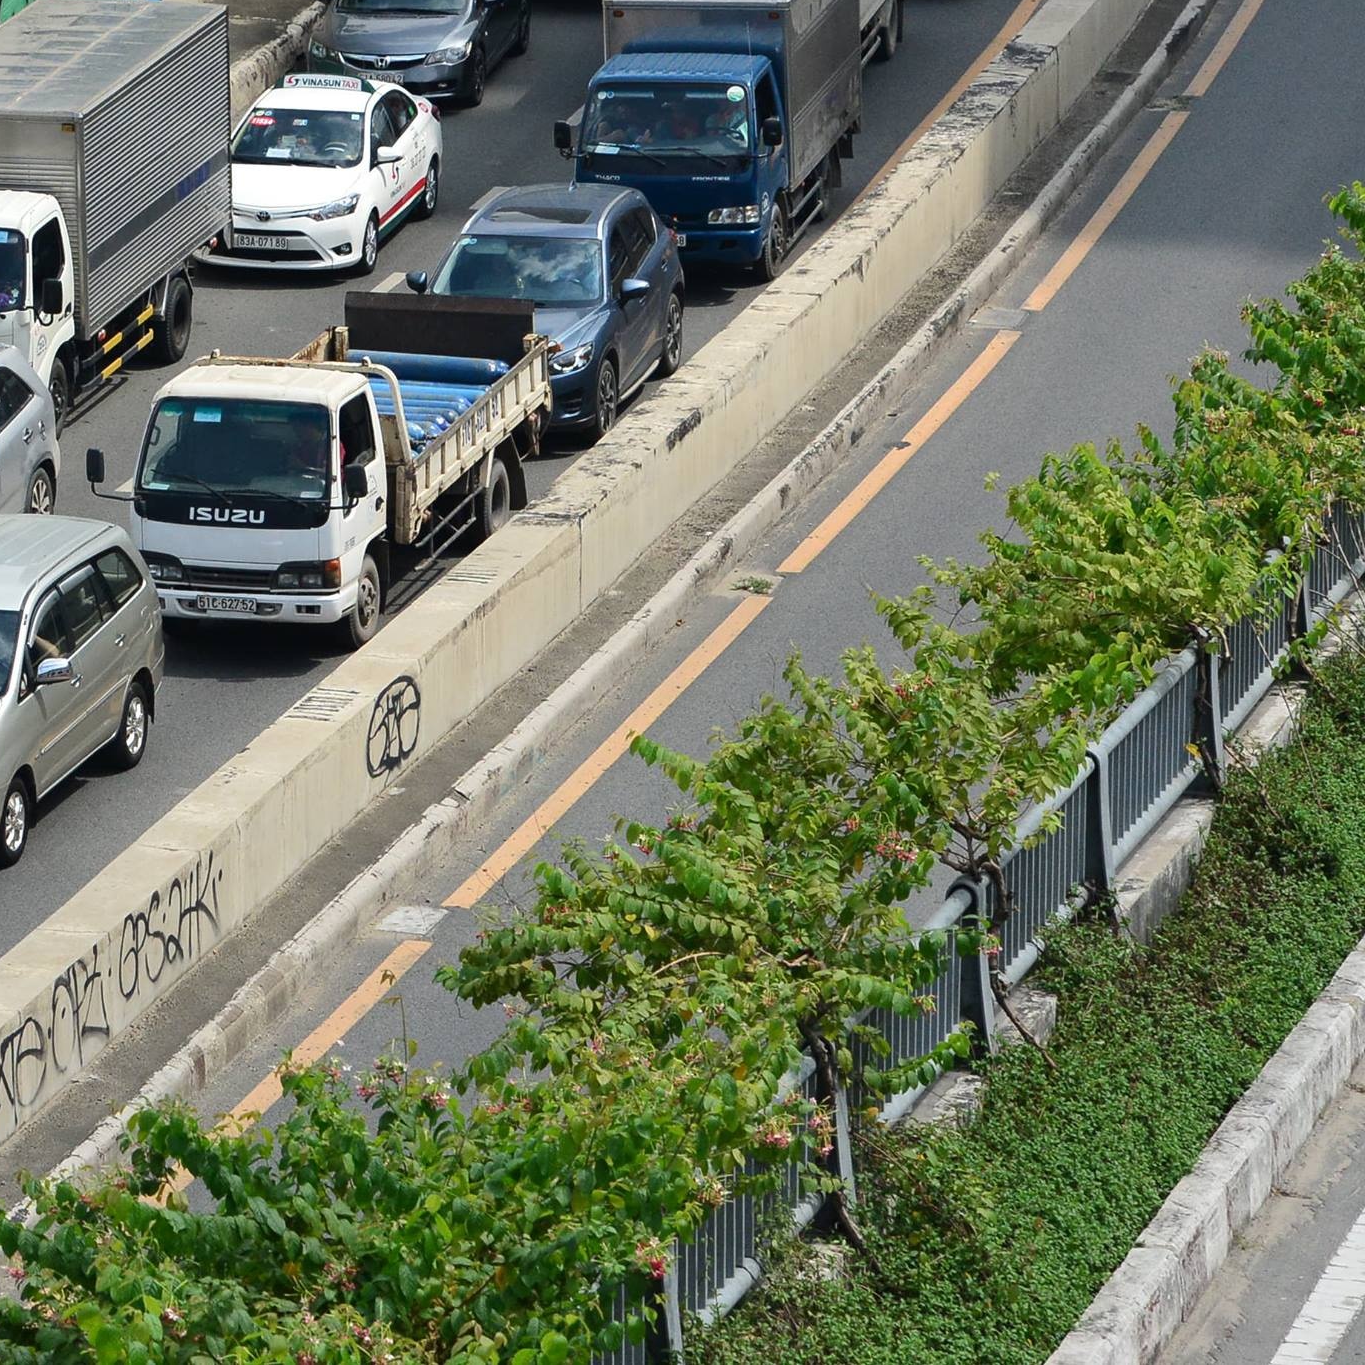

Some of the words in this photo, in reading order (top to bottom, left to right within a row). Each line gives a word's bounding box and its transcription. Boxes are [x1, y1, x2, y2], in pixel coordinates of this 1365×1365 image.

[302, 78, 341, 87] VINASUN
[342, 80, 359, 89] TAXI
[189, 507, 265, 524] ISUZU
